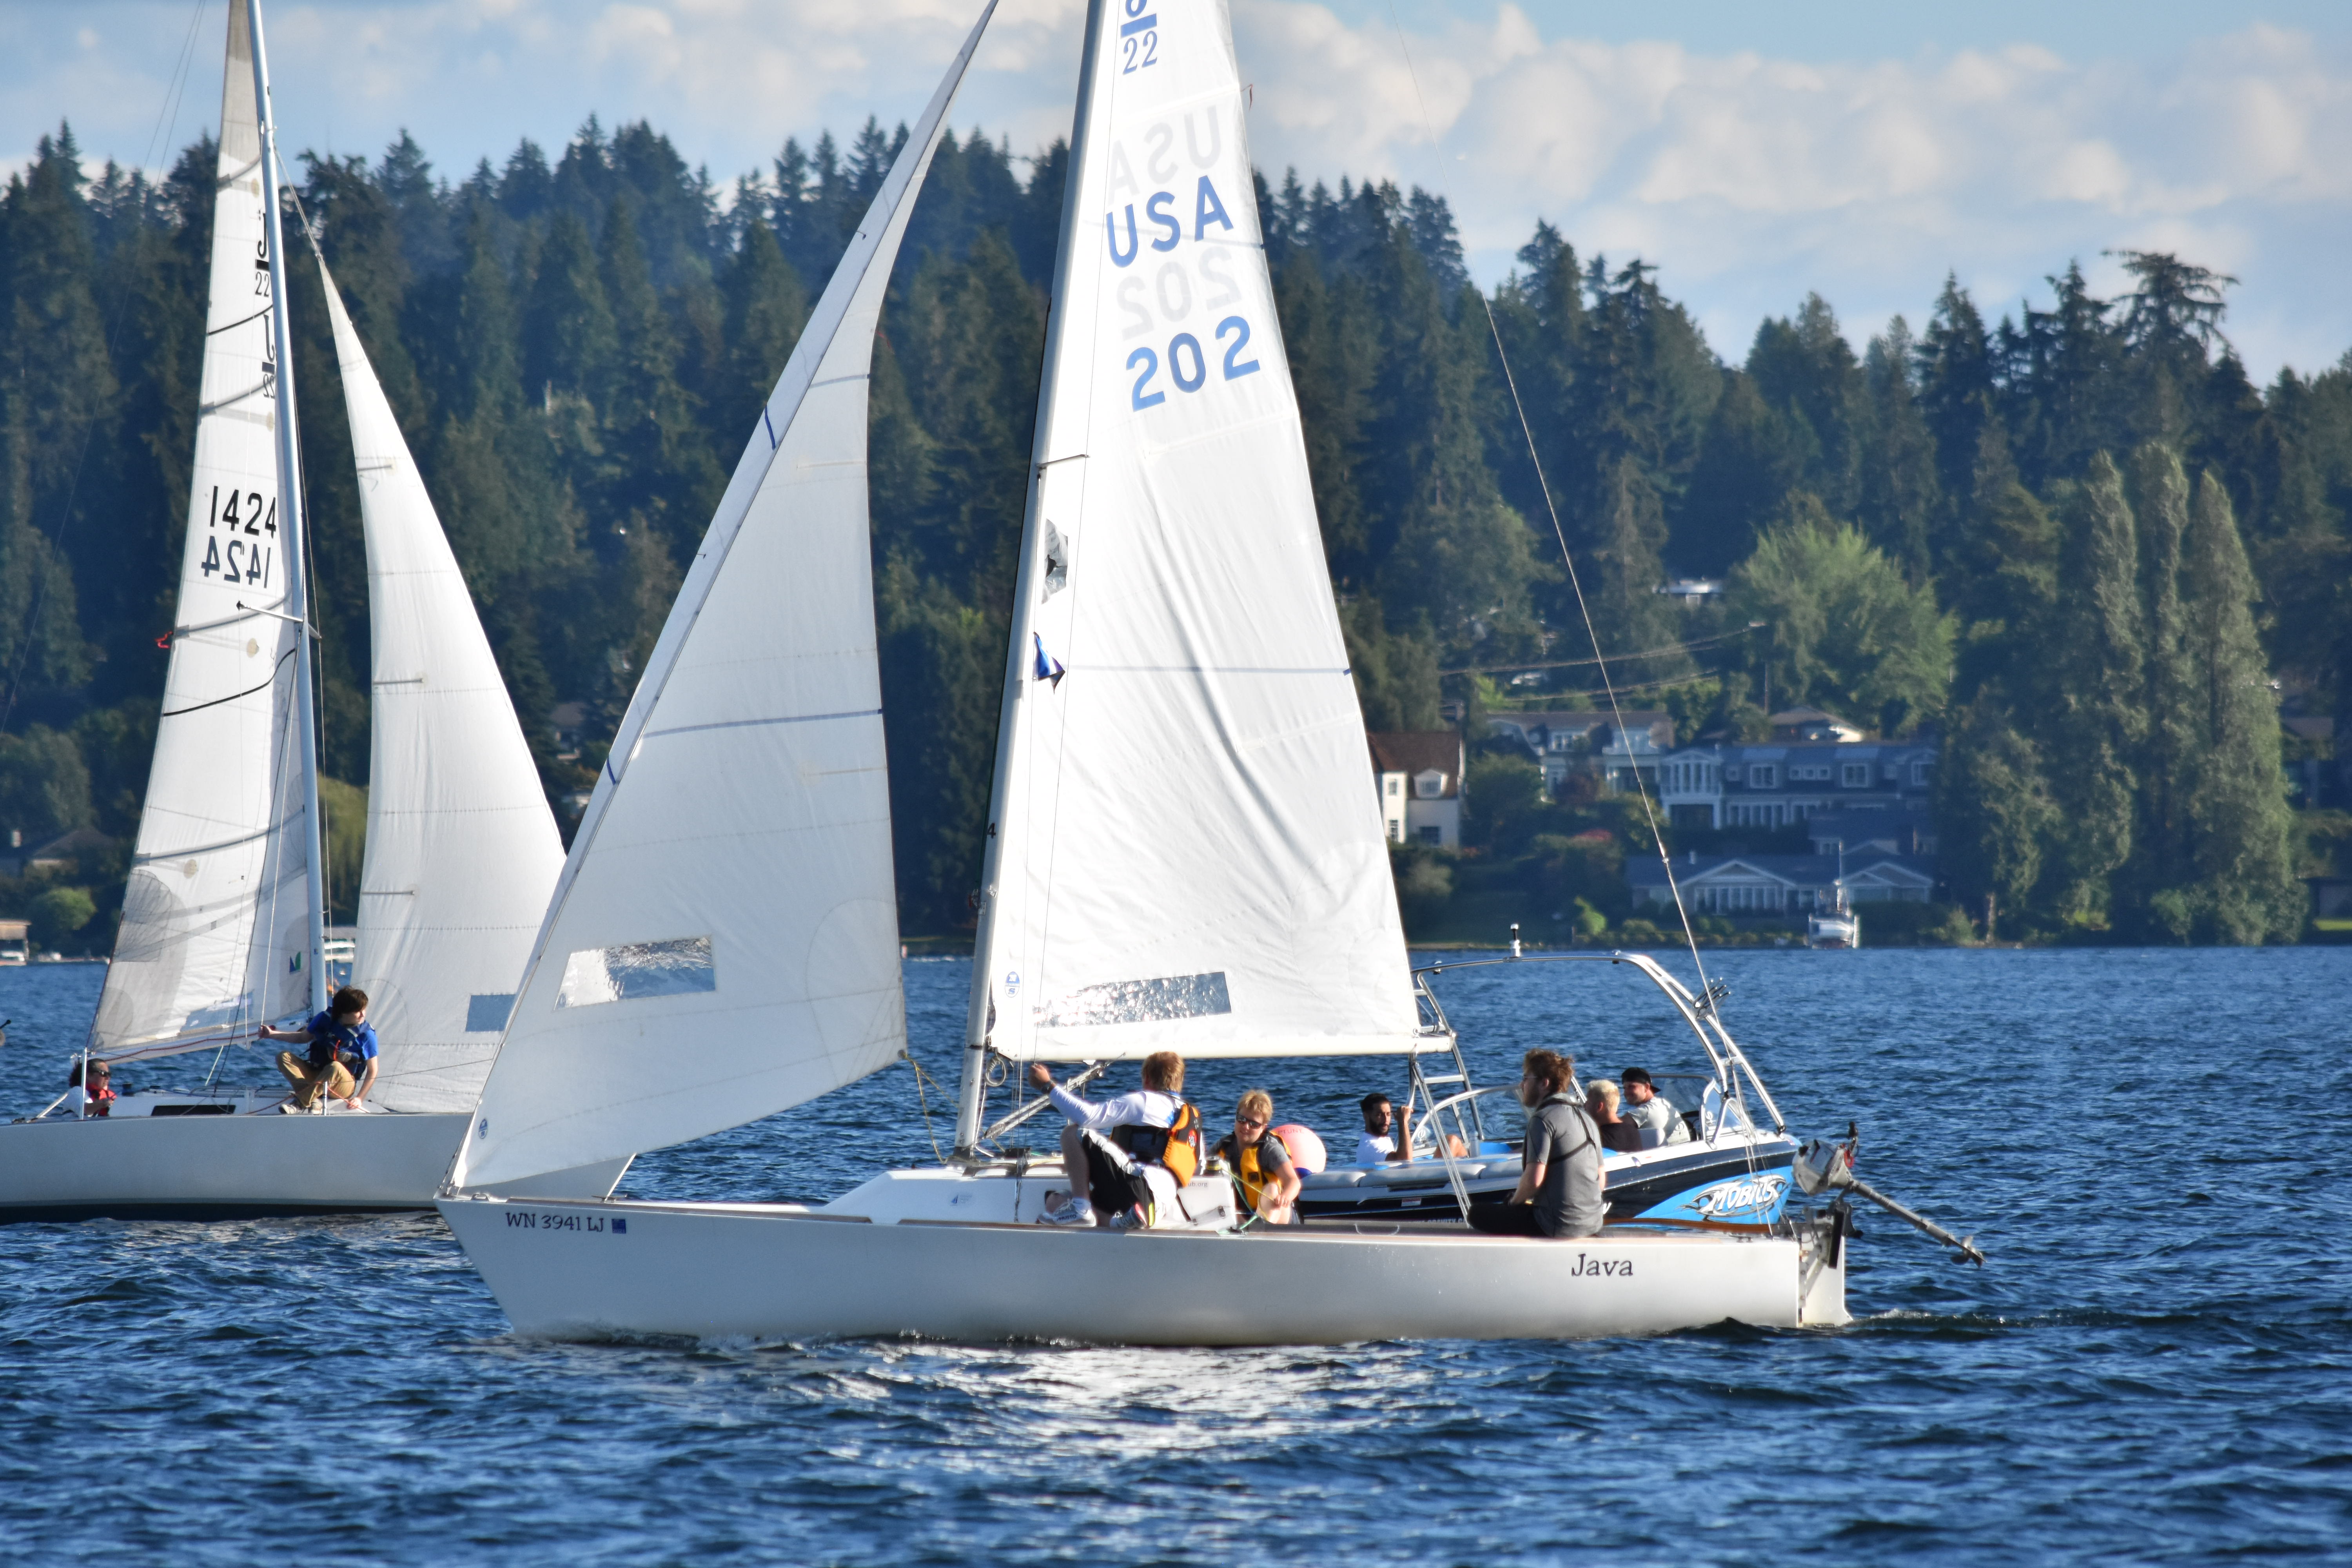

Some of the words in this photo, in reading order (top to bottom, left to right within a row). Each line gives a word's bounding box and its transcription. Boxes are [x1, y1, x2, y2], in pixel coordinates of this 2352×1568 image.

[1123, 31, 1158, 75] 22
[1106, 175, 1234, 268] USA
[255, 271, 270, 298] 22
[1125, 316, 1260, 412] 202
[209, 485, 277, 539] 1424
[1700, 1181, 1779, 1212] MOBIUS
[505, 1212, 535, 1228] WN
[541, 1215, 581, 1230] 3941
[587, 1217, 604, 1232] LJ
[1571, 1253, 1634, 1277] Java
